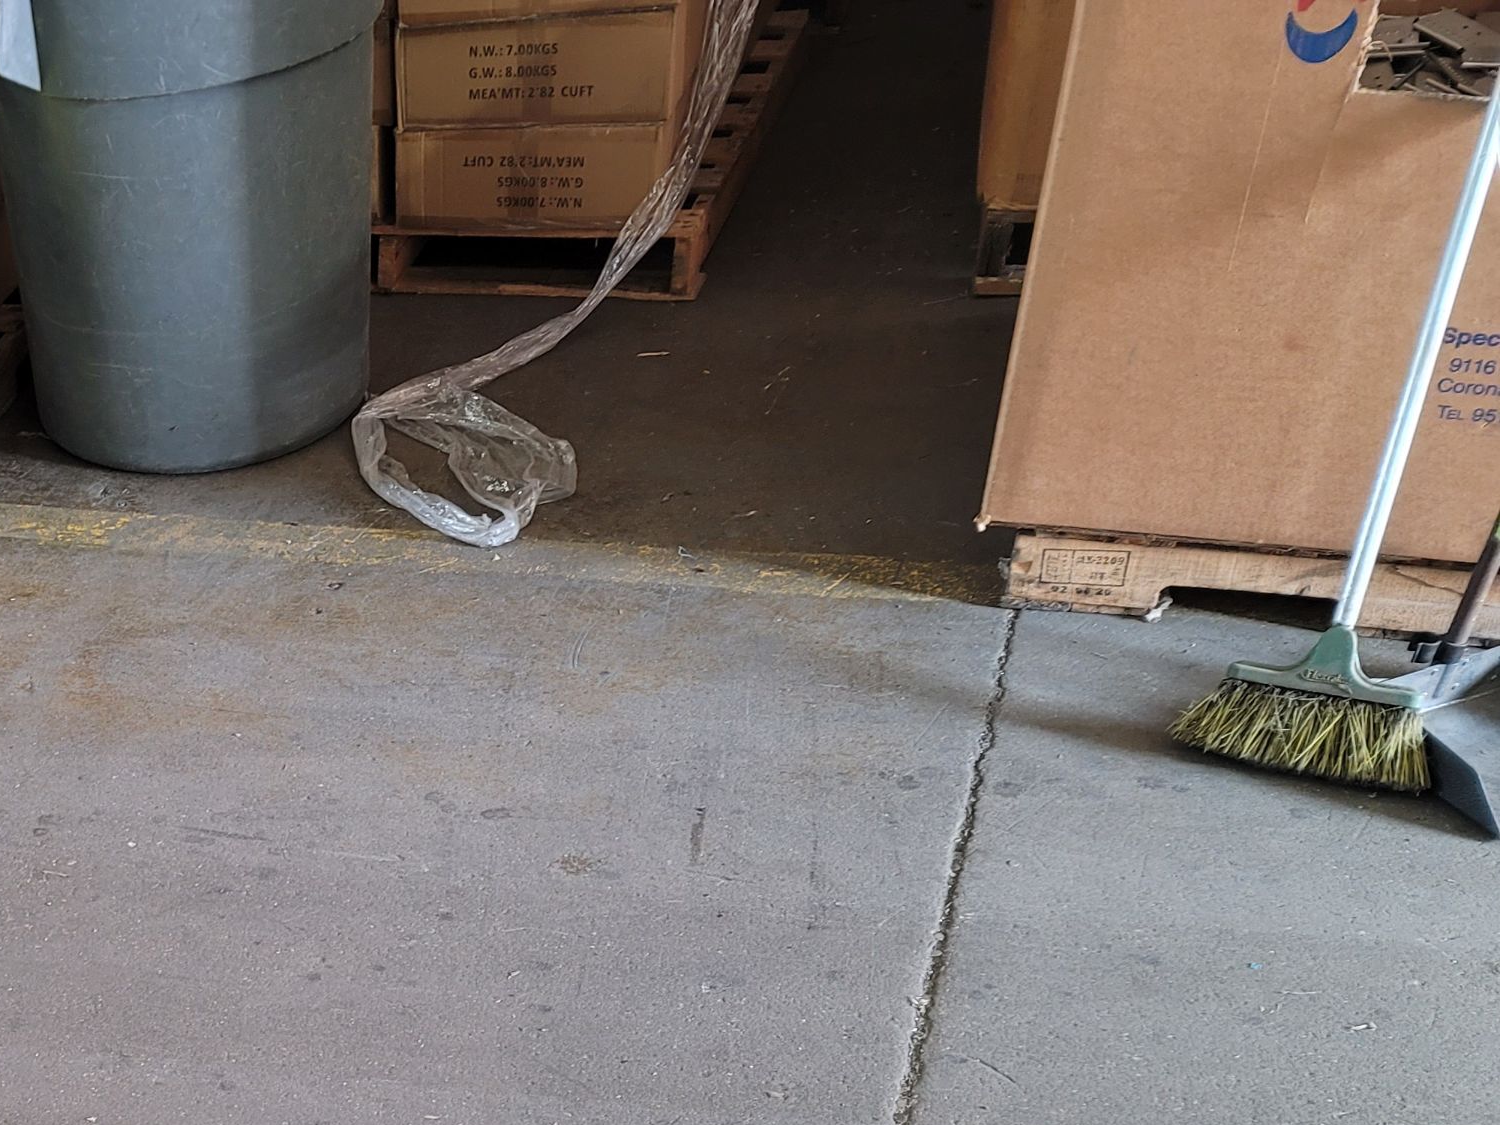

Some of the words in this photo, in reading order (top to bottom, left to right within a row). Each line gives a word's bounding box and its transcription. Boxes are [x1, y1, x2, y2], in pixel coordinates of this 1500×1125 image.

[561, 85, 594, 97] CUFT
[462, 156, 494, 168] CUFT
[1449, 358, 1497, 375] 9116
[1437, 378, 1500, 395] Coron
[1472, 408, 1500, 423] 95
